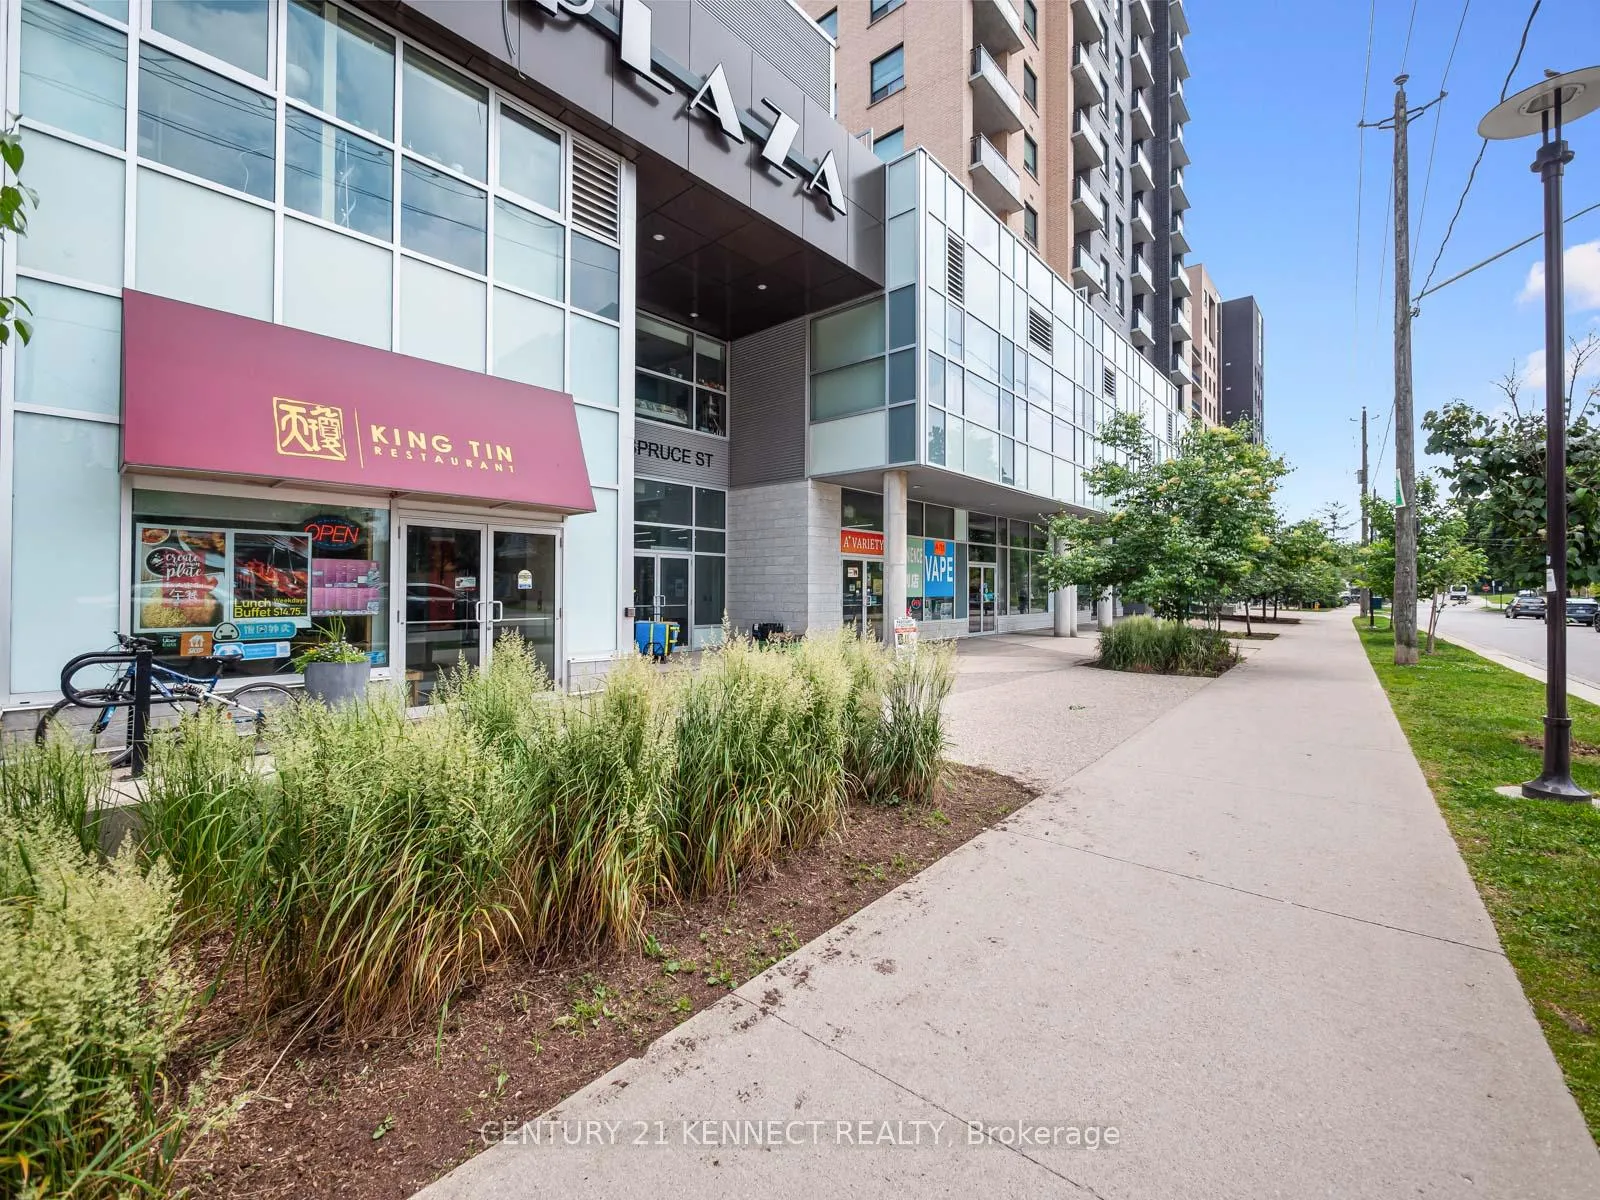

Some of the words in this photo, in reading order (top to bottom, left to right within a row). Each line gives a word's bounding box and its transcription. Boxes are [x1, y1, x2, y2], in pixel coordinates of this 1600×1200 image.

[529, 0, 847, 216] LAZA
[370, 424, 453, 453] KING
[468, 440, 513, 463] TIN
[374, 446, 516, 473] RESTAURANT
[695, 451, 714, 468] ST
[304, 523, 359, 544] OPEN
[852, 537, 884, 551] VARIETY
[165, 563, 202, 581] plate
[924, 555, 953, 582] VAPE
[234, 598, 272, 608] Lunch
[234, 607, 272, 618] Buffet
[273, 607, 301, 617] $14.75
